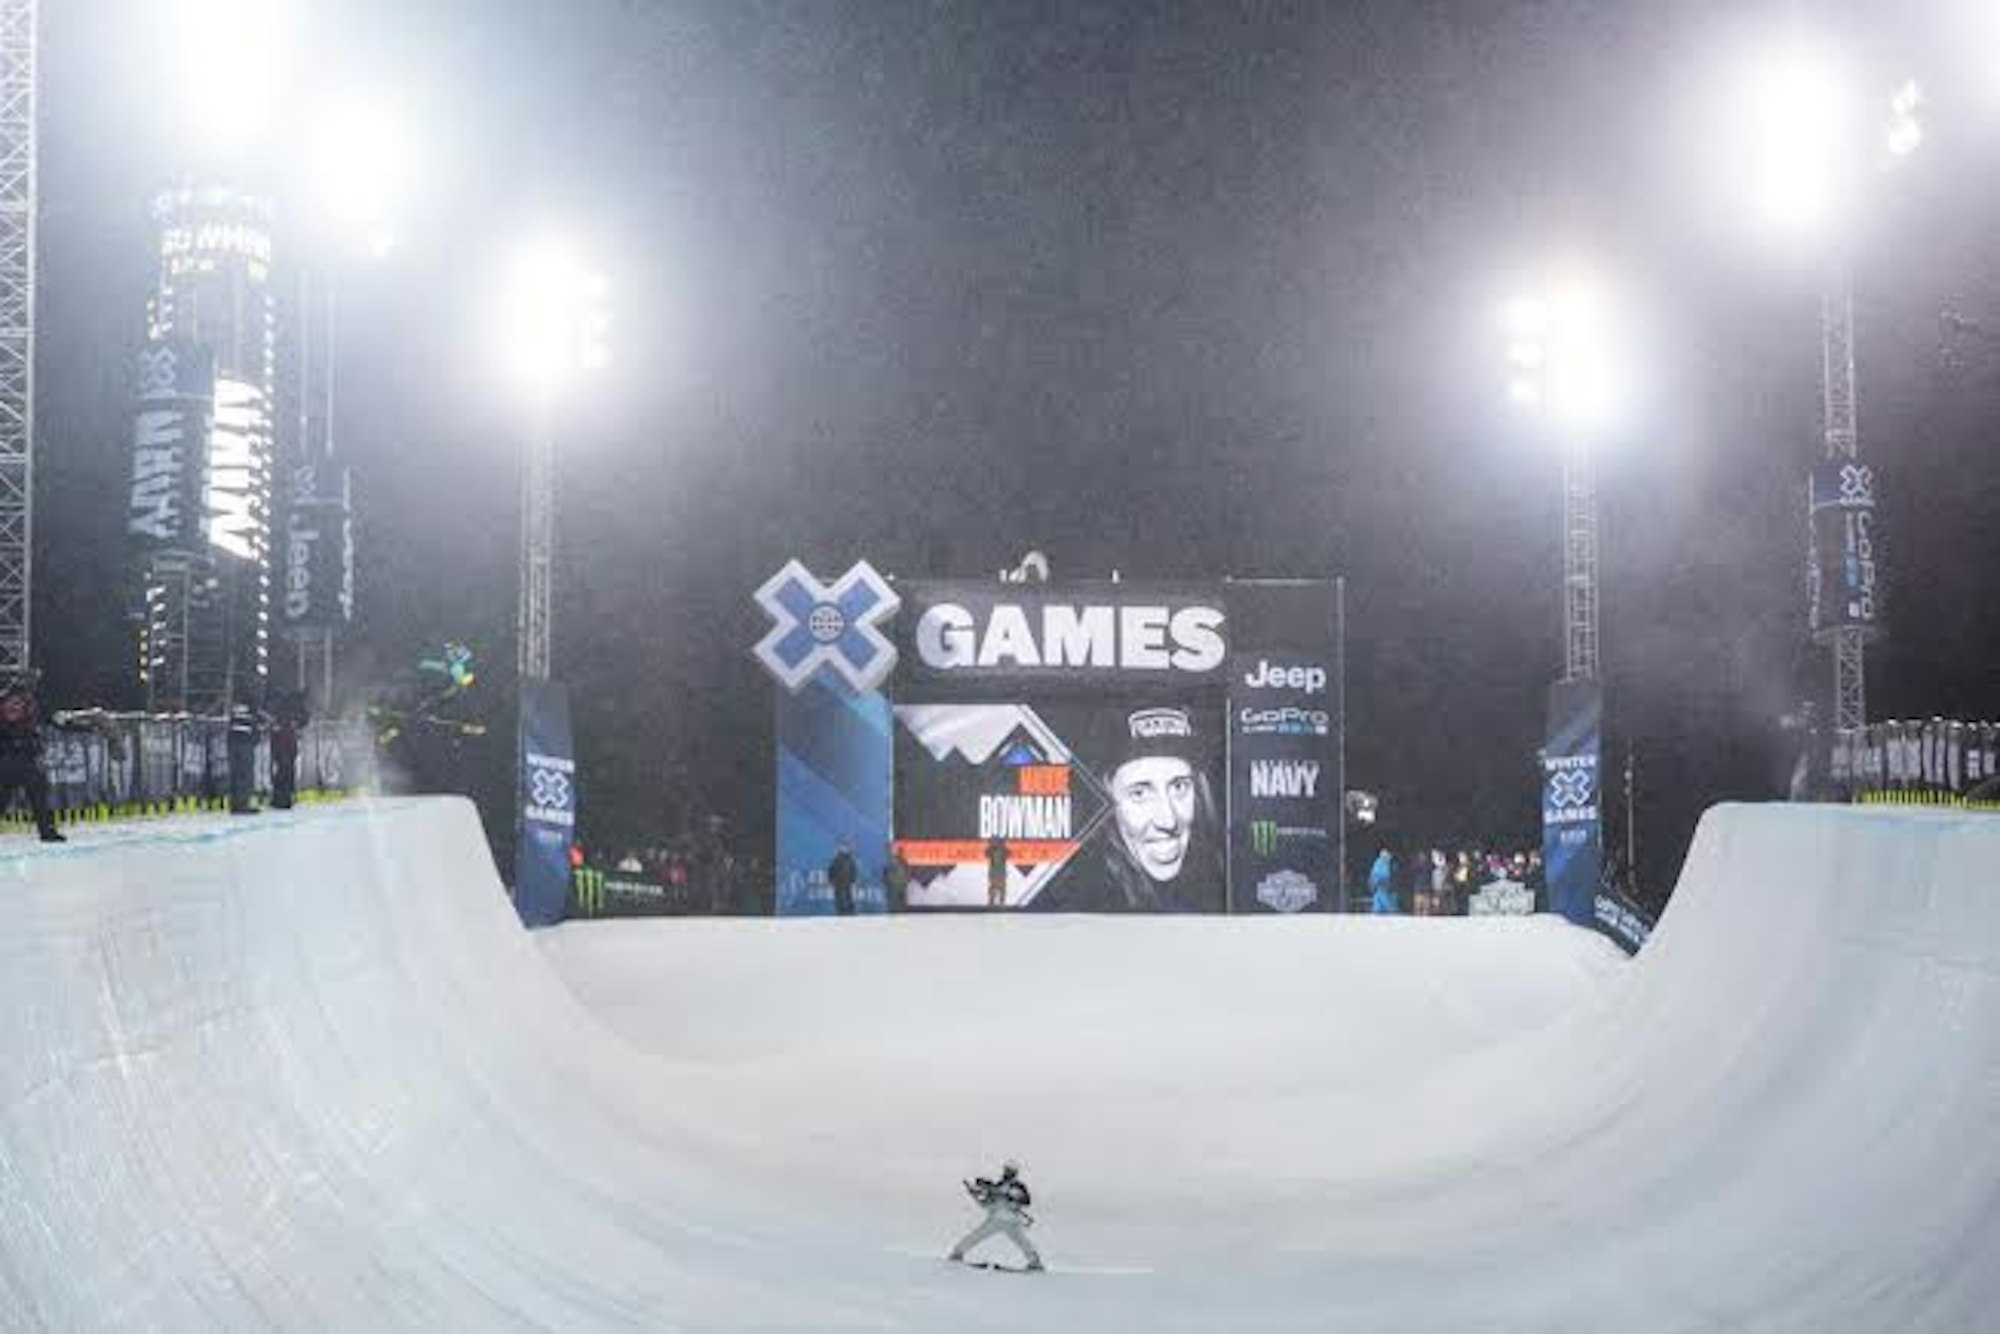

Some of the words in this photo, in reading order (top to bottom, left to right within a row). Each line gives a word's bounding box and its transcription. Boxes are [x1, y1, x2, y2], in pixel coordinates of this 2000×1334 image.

[916, 602, 1227, 672] GAMES
[1244, 660, 1327, 694] Jeep
[1250, 759, 1319, 796] NAVY
[980, 796, 1072, 838] BOWMAN
